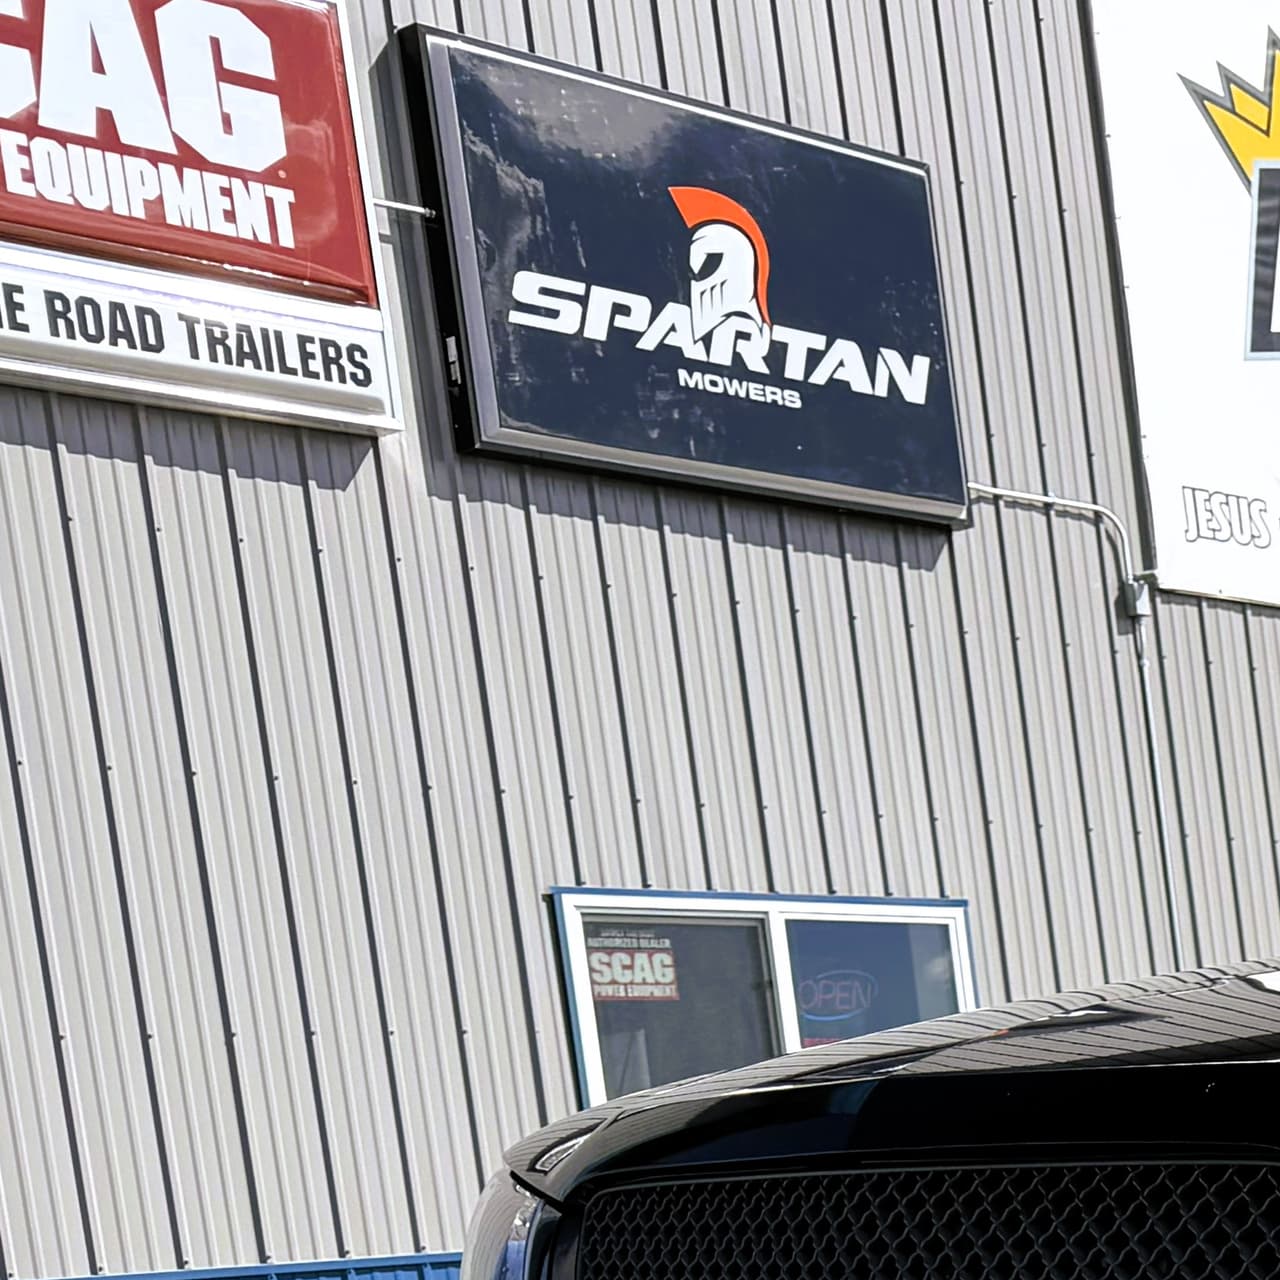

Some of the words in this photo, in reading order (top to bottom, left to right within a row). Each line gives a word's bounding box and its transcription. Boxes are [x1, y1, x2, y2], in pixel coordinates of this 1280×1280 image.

[0, 128, 295, 249] EQUIPMENT
[0, 283, 30, 333] E
[43, 289, 165, 354] ROAD
[178, 312, 372, 388] TRAILERS
[508, 270, 931, 405] SPARTAN
[678, 368, 802, 409] MOWERS
[1182, 485, 1271, 549] JESUS
[588, 951, 675, 984] SCAG
[799, 979, 872, 1010] OPEN
